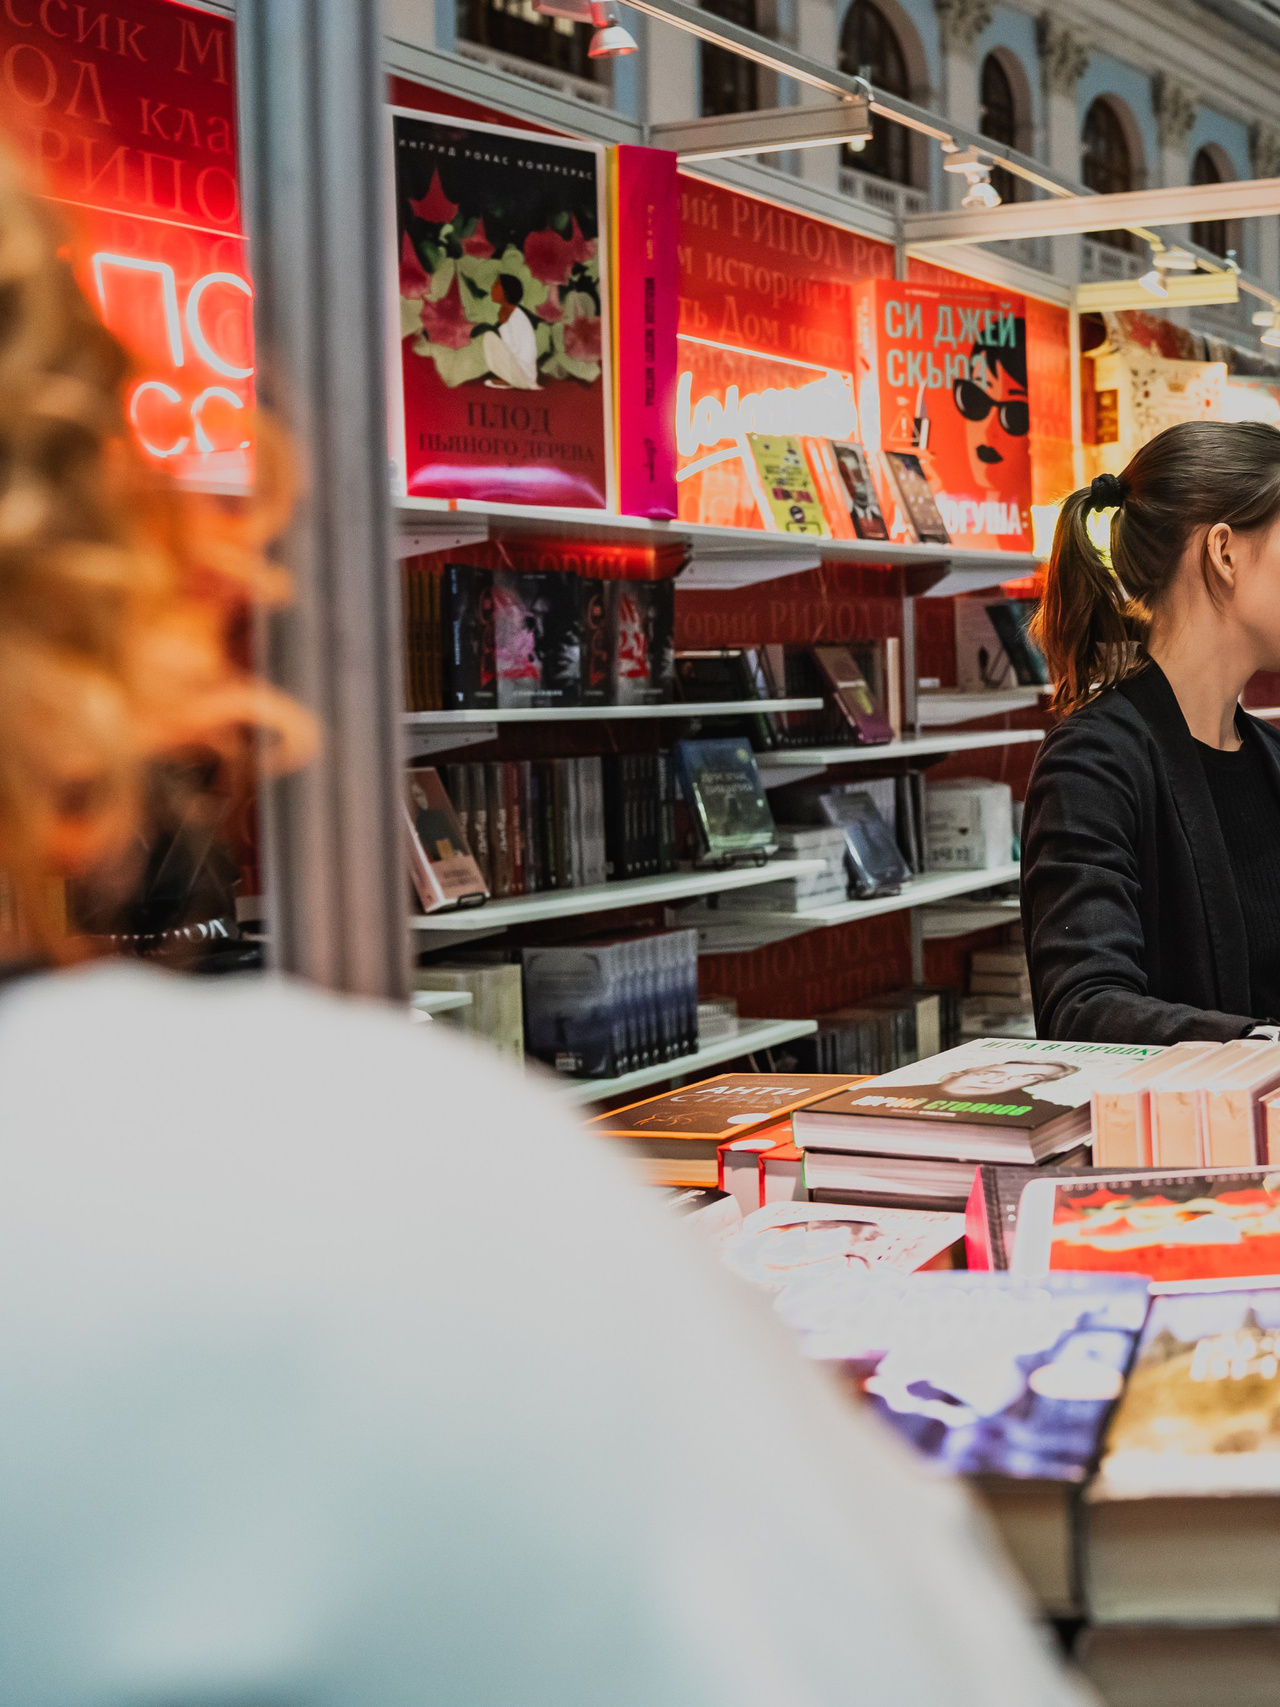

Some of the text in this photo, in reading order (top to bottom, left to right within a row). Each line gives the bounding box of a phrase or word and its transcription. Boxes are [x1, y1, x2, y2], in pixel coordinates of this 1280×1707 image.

[884, 299, 923, 340] СИ
[933, 301, 1017, 350] ДЖЕЙ
[467, 401, 551, 437] ПЛОД
[980, 1040, 1037, 1052] ИГРА
[1040, 1042, 1057, 1052] В
[695, 1085, 811, 1097] АНТИ
[923, 1098, 1034, 1118] СТОЯНОВ
